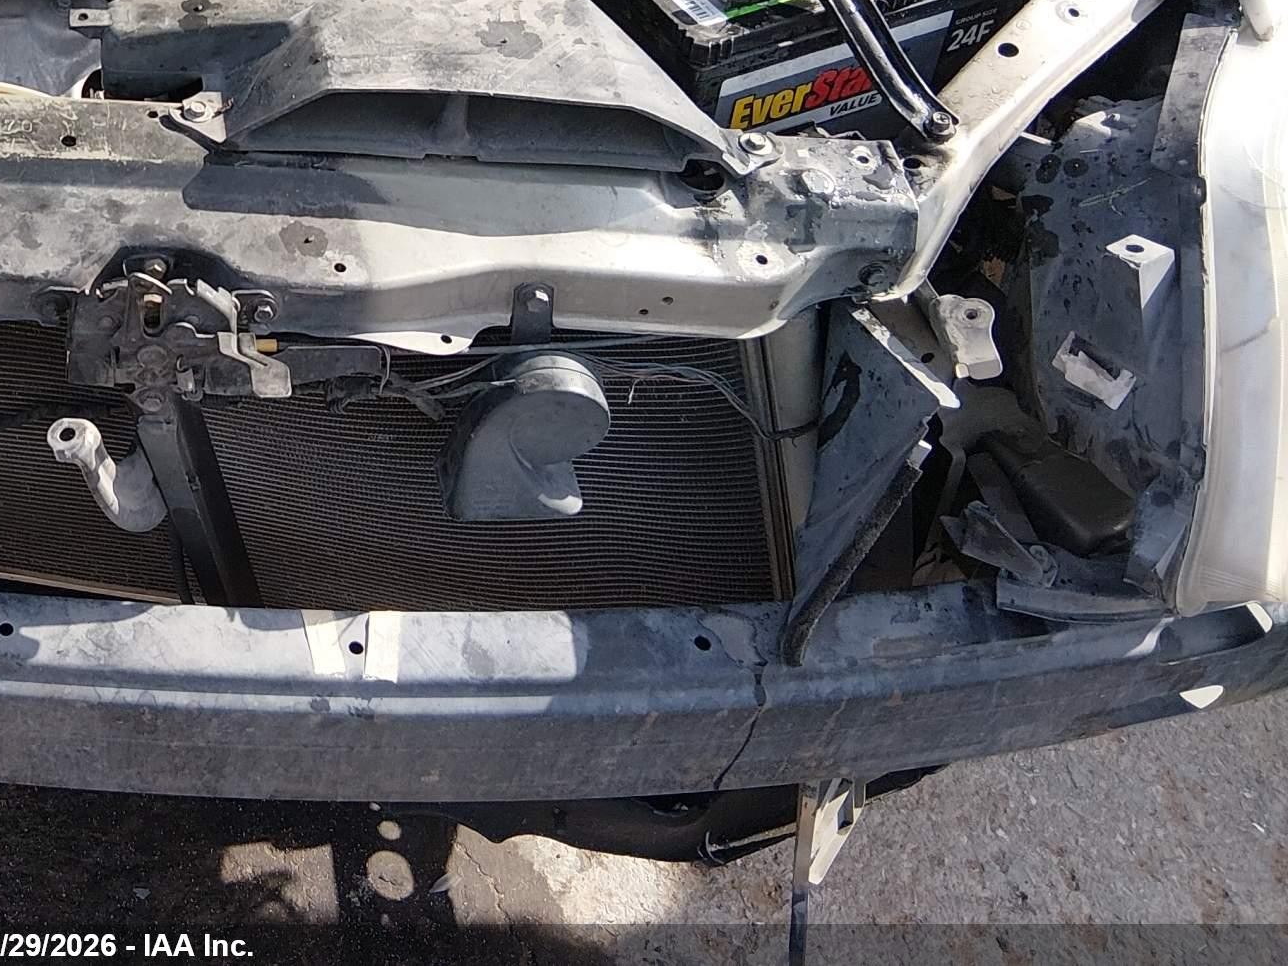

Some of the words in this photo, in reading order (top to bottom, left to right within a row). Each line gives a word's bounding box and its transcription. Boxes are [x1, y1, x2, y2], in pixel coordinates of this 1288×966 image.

[946, 19, 995, 52] 24F
[730, 65, 874, 130] EverSta
[829, 92, 880, 117] VALUE
